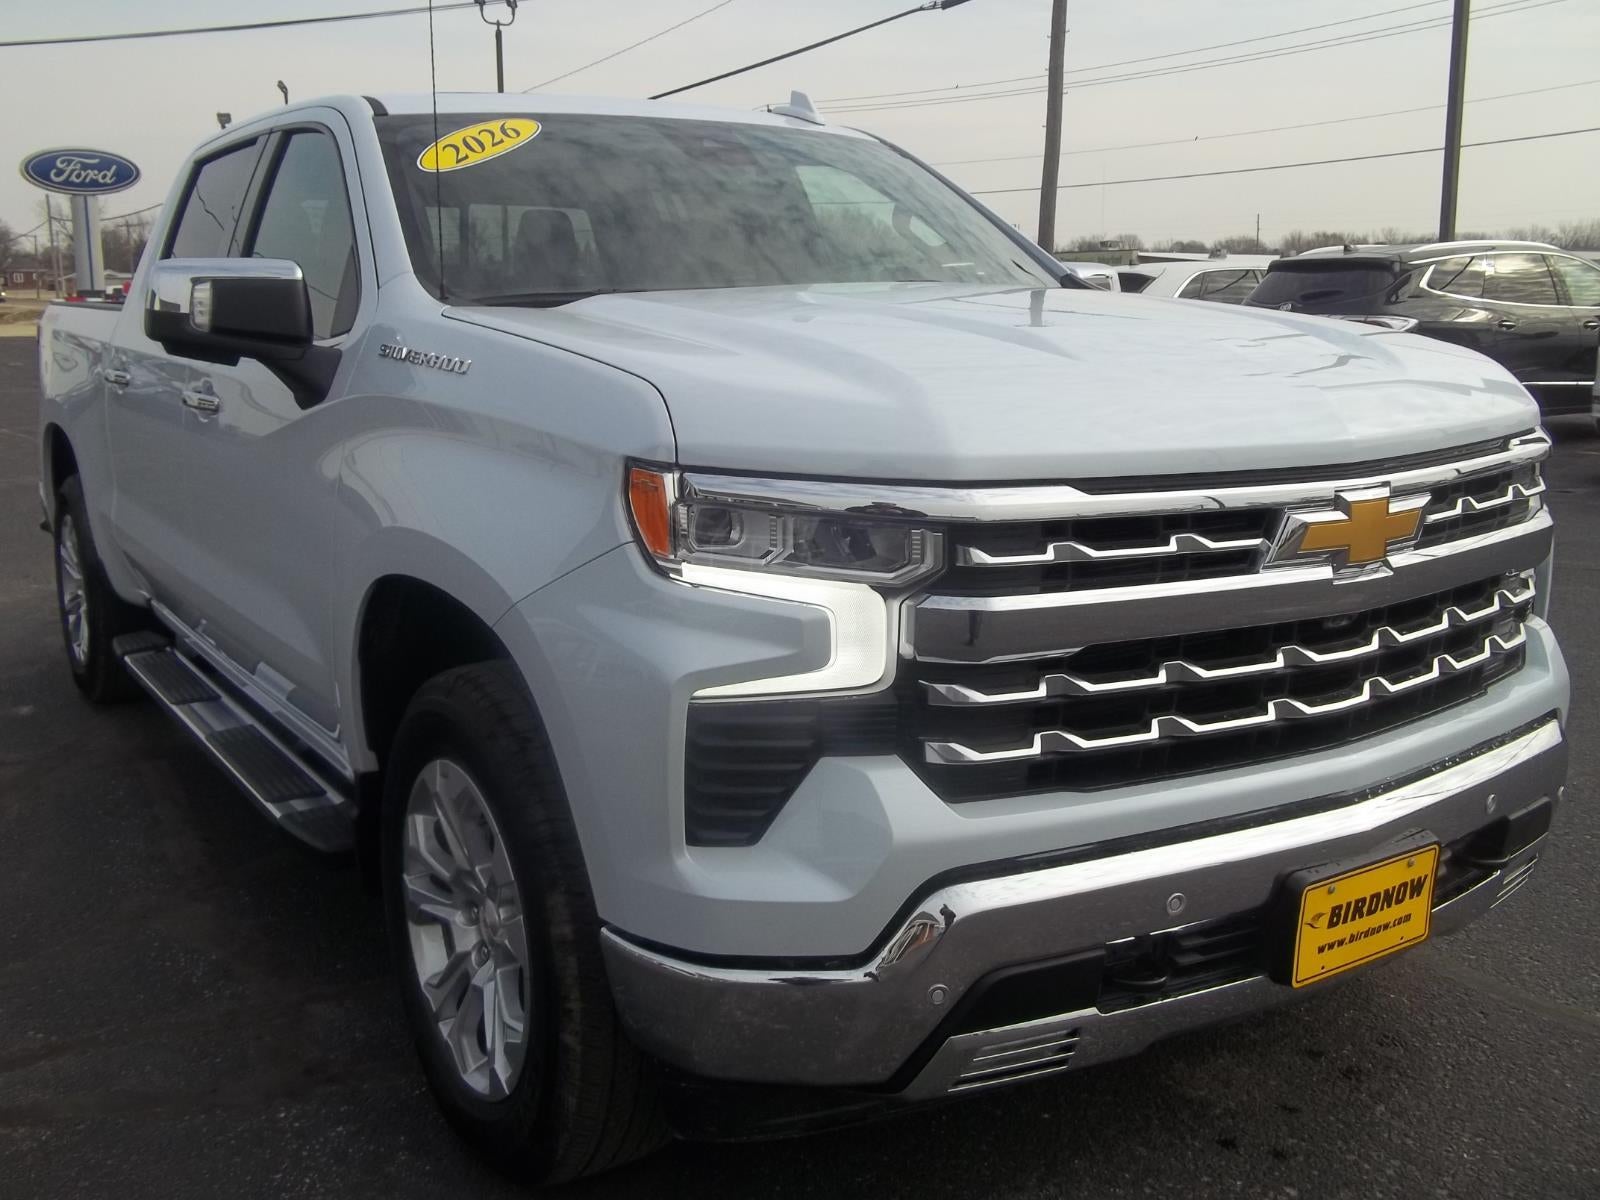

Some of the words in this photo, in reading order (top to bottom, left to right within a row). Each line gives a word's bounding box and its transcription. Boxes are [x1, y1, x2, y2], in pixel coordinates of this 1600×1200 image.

[442, 121, 521, 164] 2026
[50, 155, 117, 184] Ford
[378, 343, 472, 375] SILVERADO
[1327, 874, 1428, 929] BIRDNOW
[1317, 913, 1412, 954] www.birdnow.com
